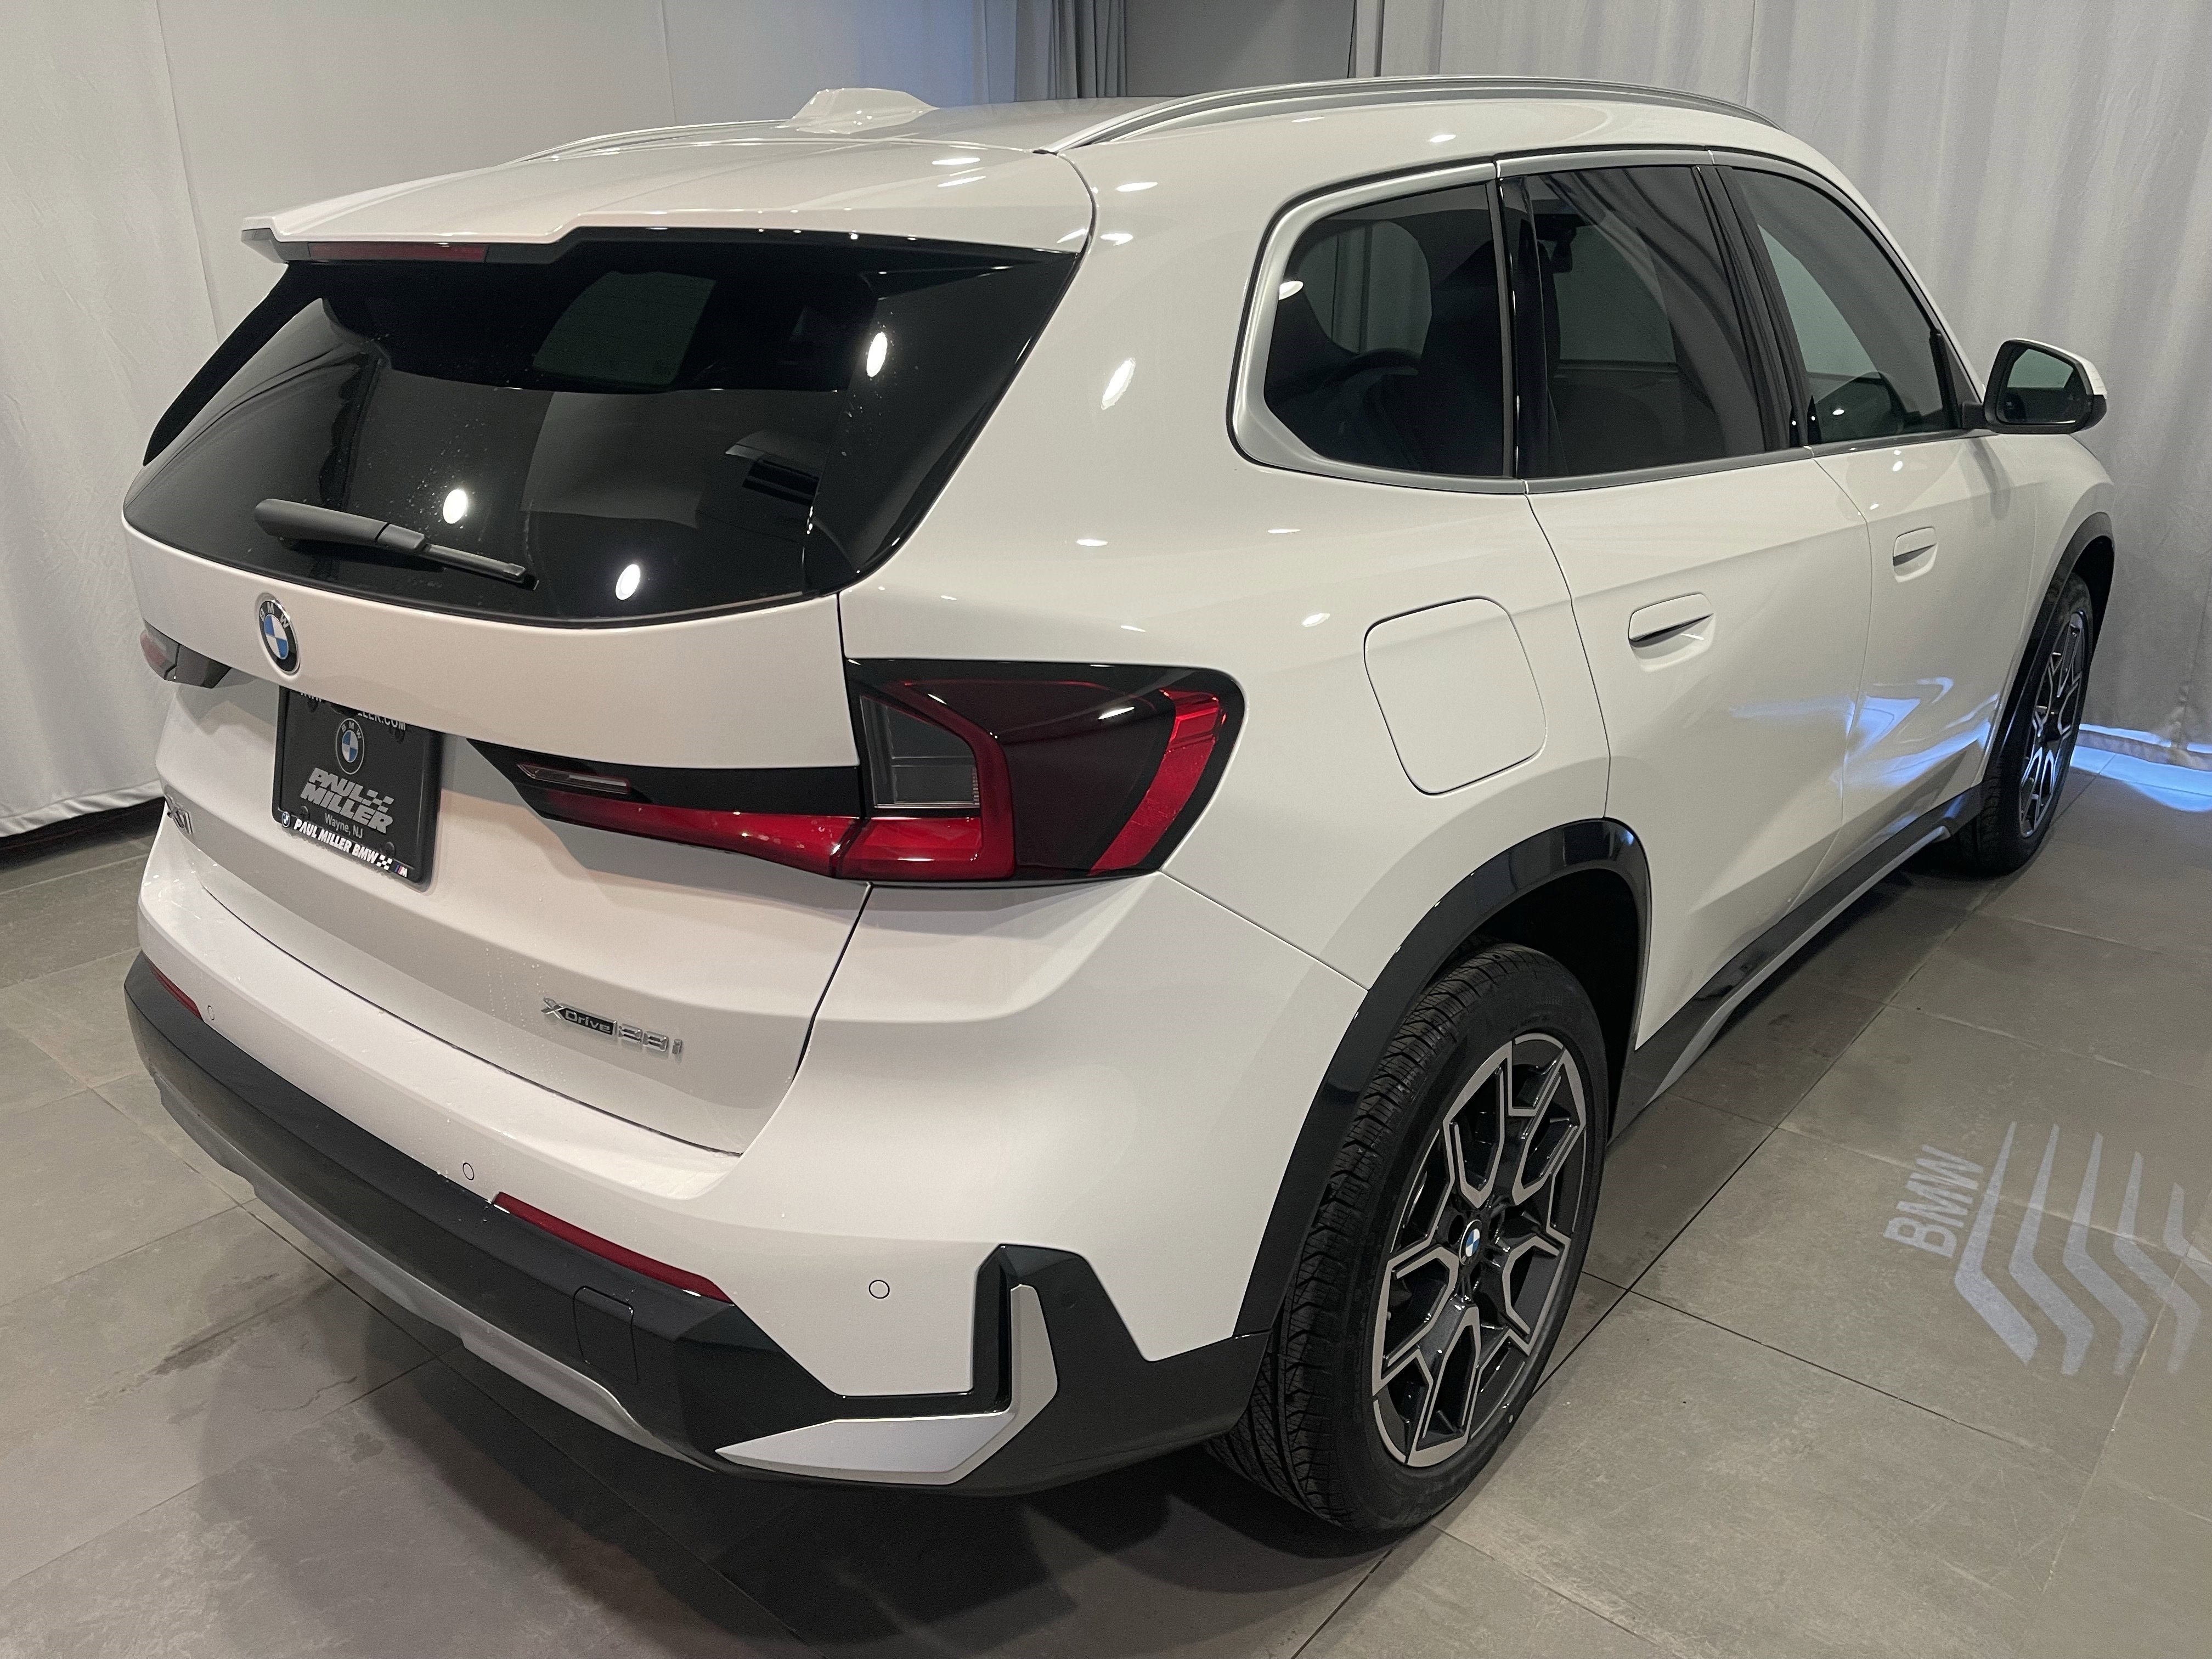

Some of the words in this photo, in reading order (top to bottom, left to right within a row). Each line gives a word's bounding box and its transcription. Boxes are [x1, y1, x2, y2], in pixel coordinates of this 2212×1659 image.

[259, 602, 289, 628] BMW
[341, 721, 362, 739] BMW
[308, 768, 364, 803] PAUL
[300, 782, 393, 834] MILLER
[325, 812, 351, 836] Wayne,
[353, 825, 363, 839] NJ
[294, 818, 318, 838] PAUL
[318, 829, 352, 853] MILLER
[352, 843, 379, 864] BMW
[1883, 1144, 1984, 1259] BMW
